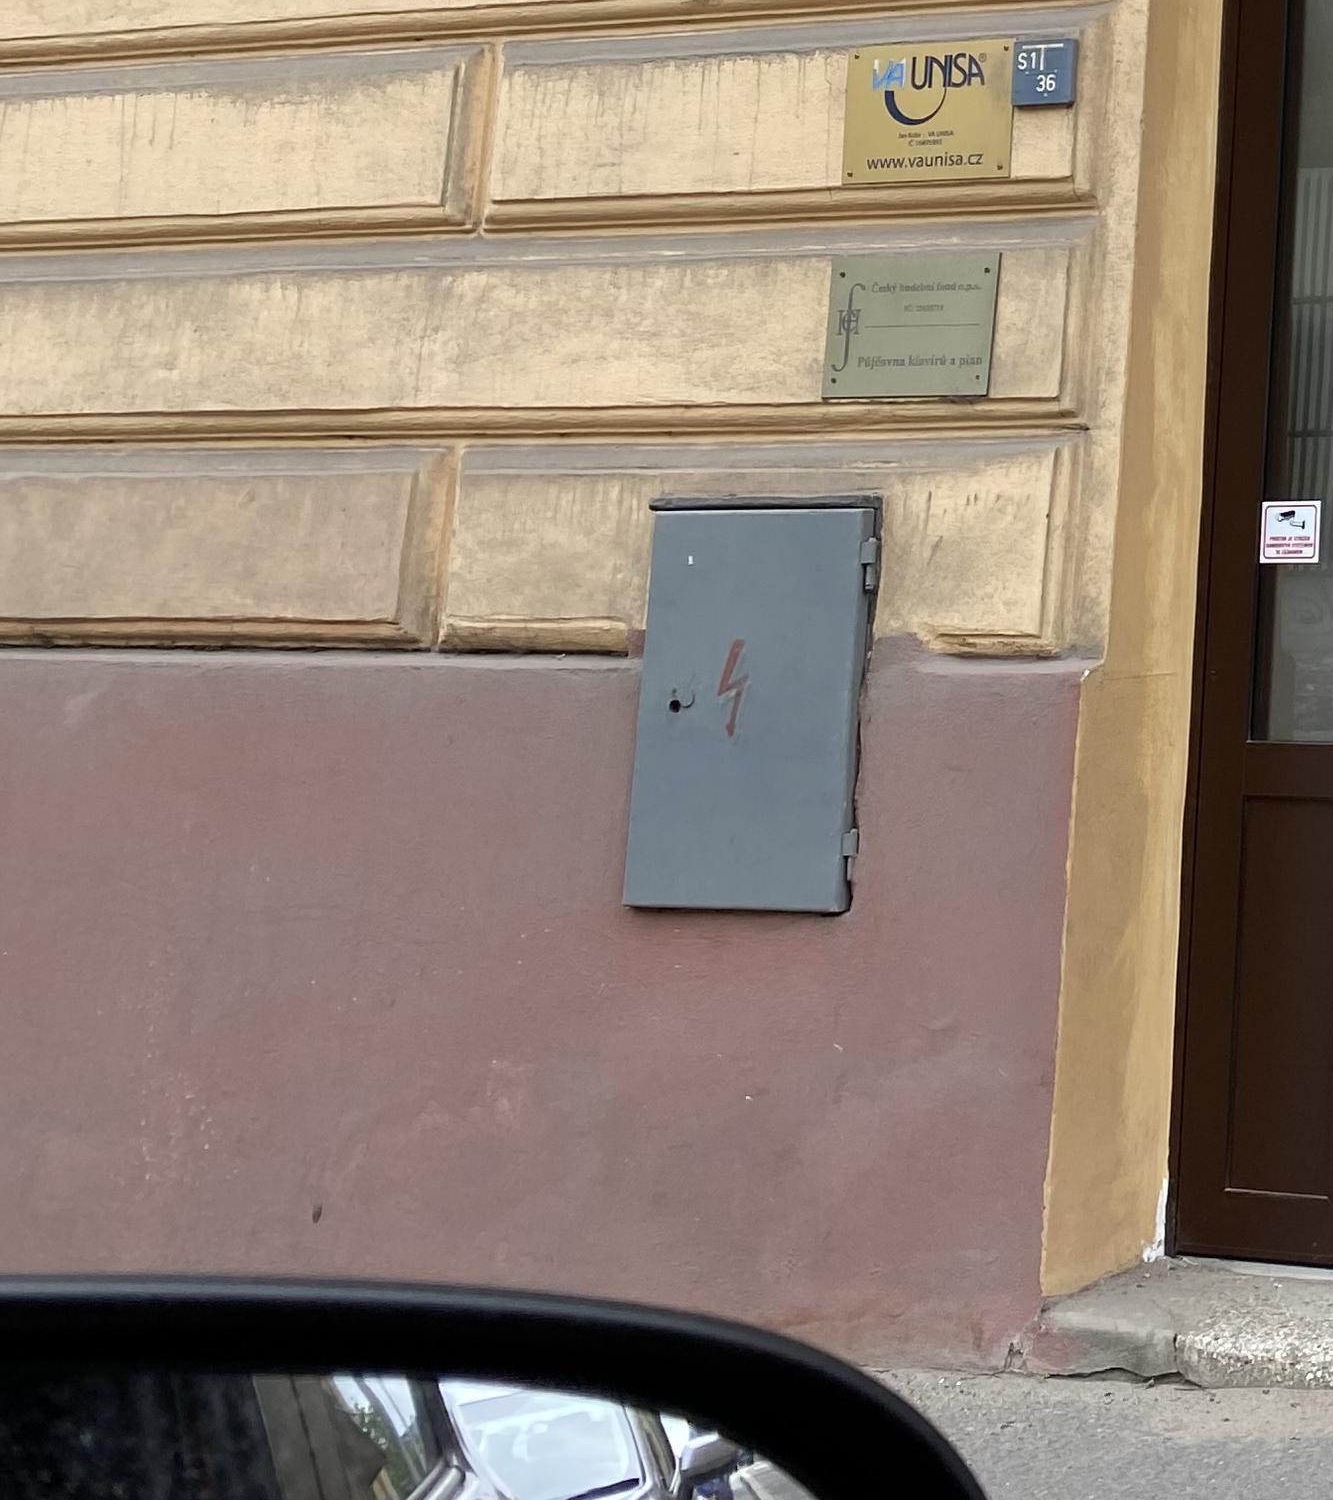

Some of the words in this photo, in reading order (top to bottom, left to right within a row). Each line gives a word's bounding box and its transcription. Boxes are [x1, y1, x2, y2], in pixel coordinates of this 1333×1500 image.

[1036, 74, 1056, 92] 36
[867, 151, 984, 170] www.vaunisa.cz
[857, 355, 906, 370] Půjčovna
